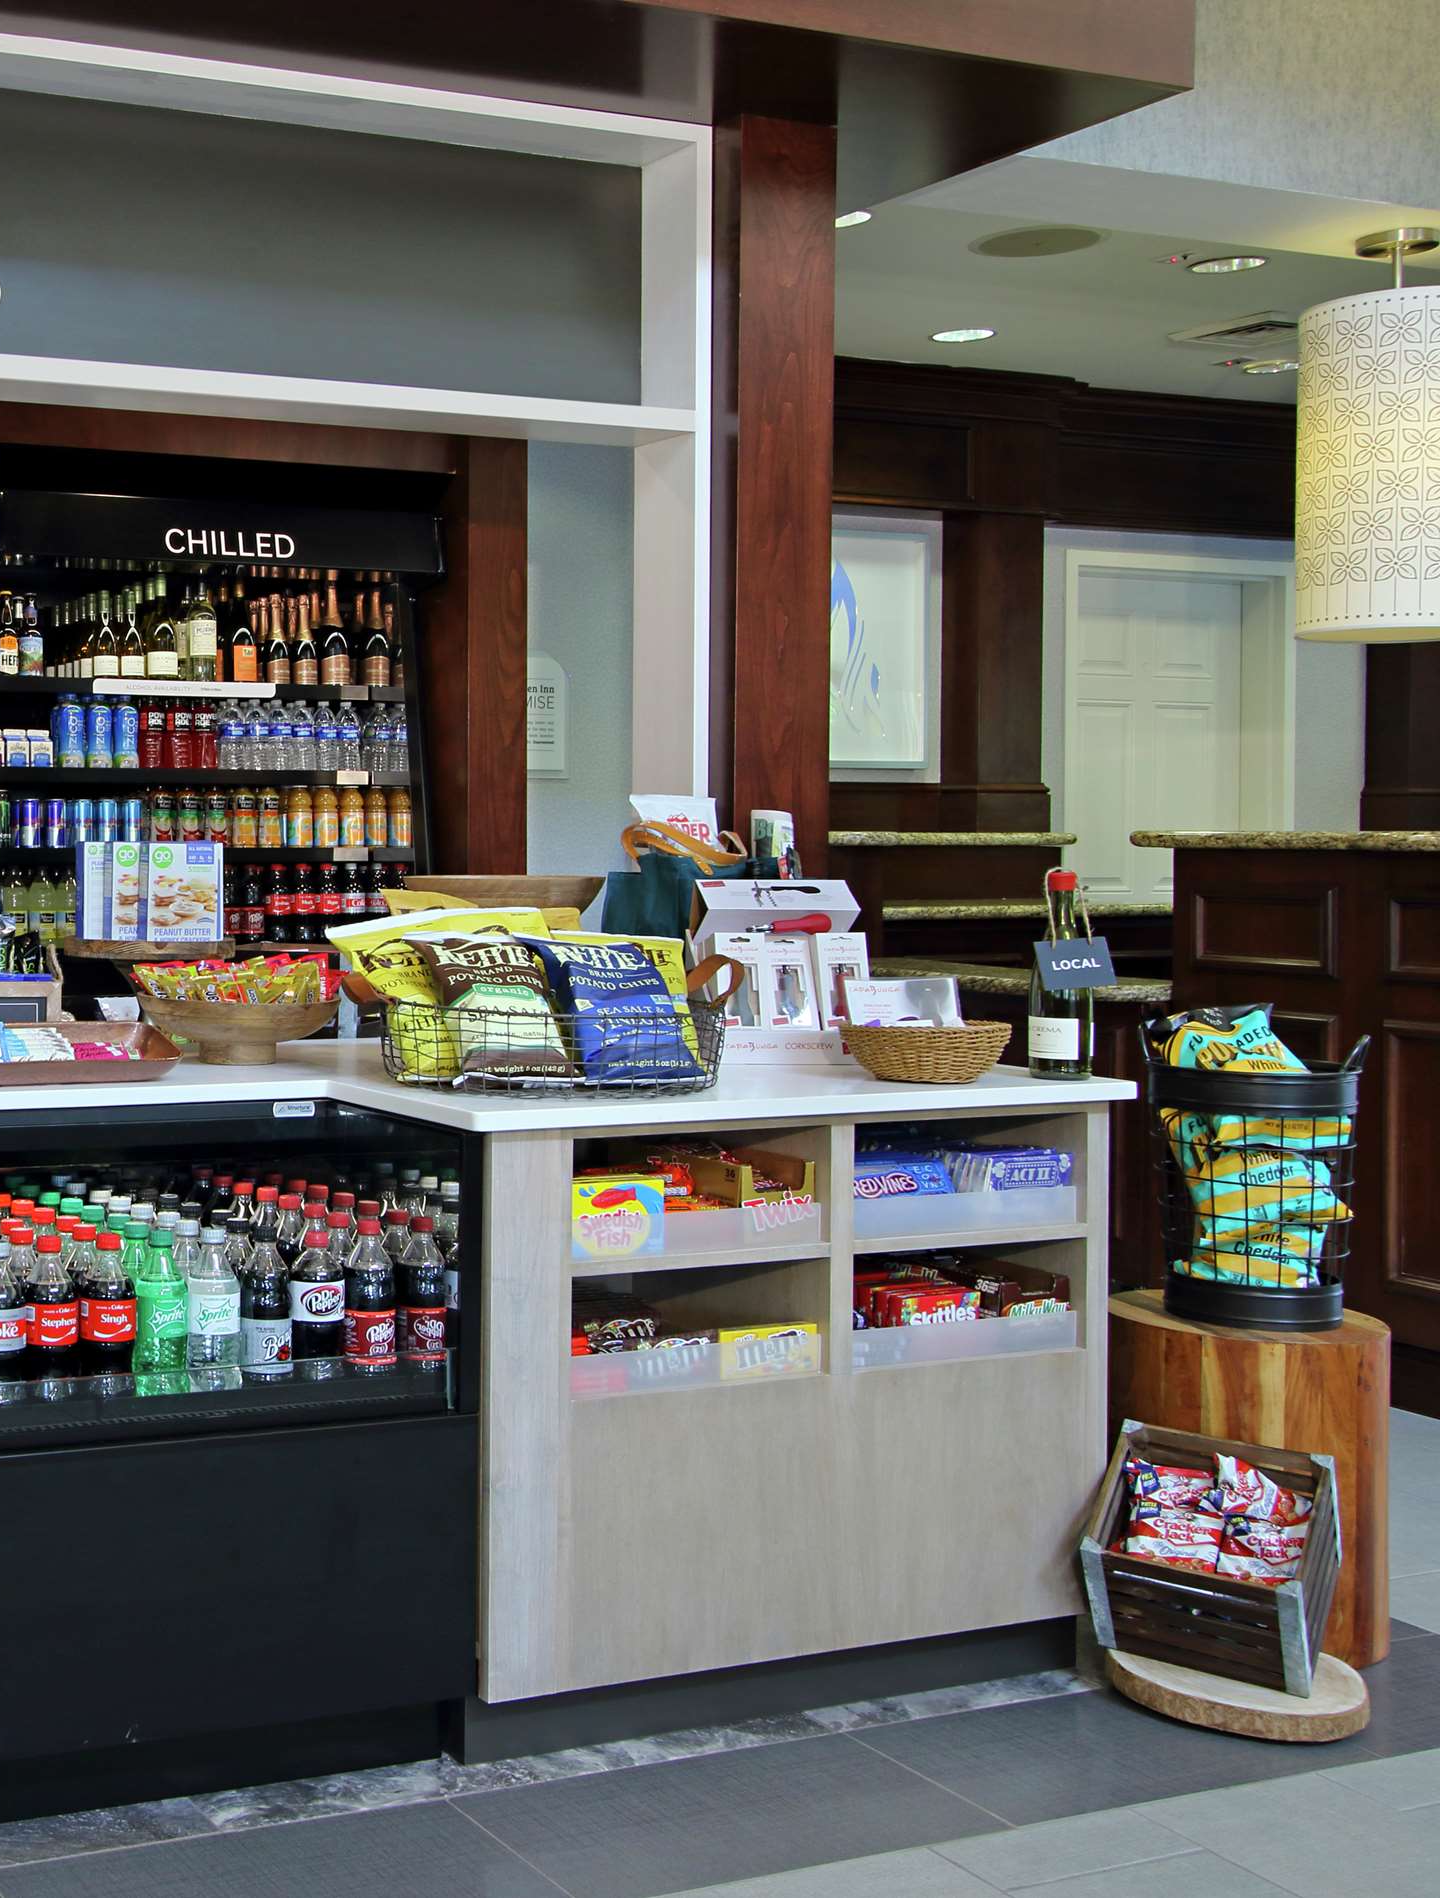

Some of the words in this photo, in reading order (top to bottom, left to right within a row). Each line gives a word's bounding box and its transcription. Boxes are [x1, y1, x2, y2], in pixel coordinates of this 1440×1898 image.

[165, 528, 295, 559] CHILLED
[540, 684, 555, 693] Inn
[96, 716, 106, 745] ZICO
[118, 851, 135, 863] go
[155, 852, 171, 863] go
[154, 928, 183, 936] PEANUT
[184, 928, 211, 936] BUTTER
[427, 940, 536, 968] KETTLE
[546, 943, 650, 970] KETTLE
[473, 965, 513, 976] BRAND
[1052, 957, 1101, 971] LOCAL
[447, 973, 503, 986] POTATO
[588, 968, 623, 979] BRAND
[568, 975, 617, 991] POTATO
[618, 978, 660, 990] CHIPS
[480, 986, 529, 996] organic
[596, 1006, 622, 1016] SEA
[622, 1005, 653, 1014] SALT
[784, 1042, 835, 1050] CORKSCREW
[494, 1065, 524, 1073] weight
[1239, 1150, 1279, 1167] White
[724, 1168, 736, 1178] 36
[1010, 1168, 1033, 1181] ACT
[1239, 1165, 1294, 1187] Cheddar
[879, 1173, 918, 1193] VINES
[742, 1191, 816, 1232] Twix
[579, 1209, 644, 1237] Swedish
[595, 1228, 630, 1249] Fish
[1233, 1240, 1291, 1265] Cheddar
[975, 1278, 988, 1292] 36
[322, 1289, 335, 1300] Dr
[309, 1293, 341, 1312] Pepper
[101, 1313, 128, 1325] Singh
[152, 1309, 185, 1325] Sprite
[198, 1308, 232, 1322] Sprite
[910, 1304, 976, 1326] Skittles
[378, 1319, 392, 1331] Dr
[367, 1326, 395, 1343] Pepper
[1153, 1518, 1212, 1534] Cracker
[1160, 1529, 1194, 1542] Jack
[1246, 1534, 1305, 1549] Cracker
[1255, 1547, 1289, 1559] Jack
